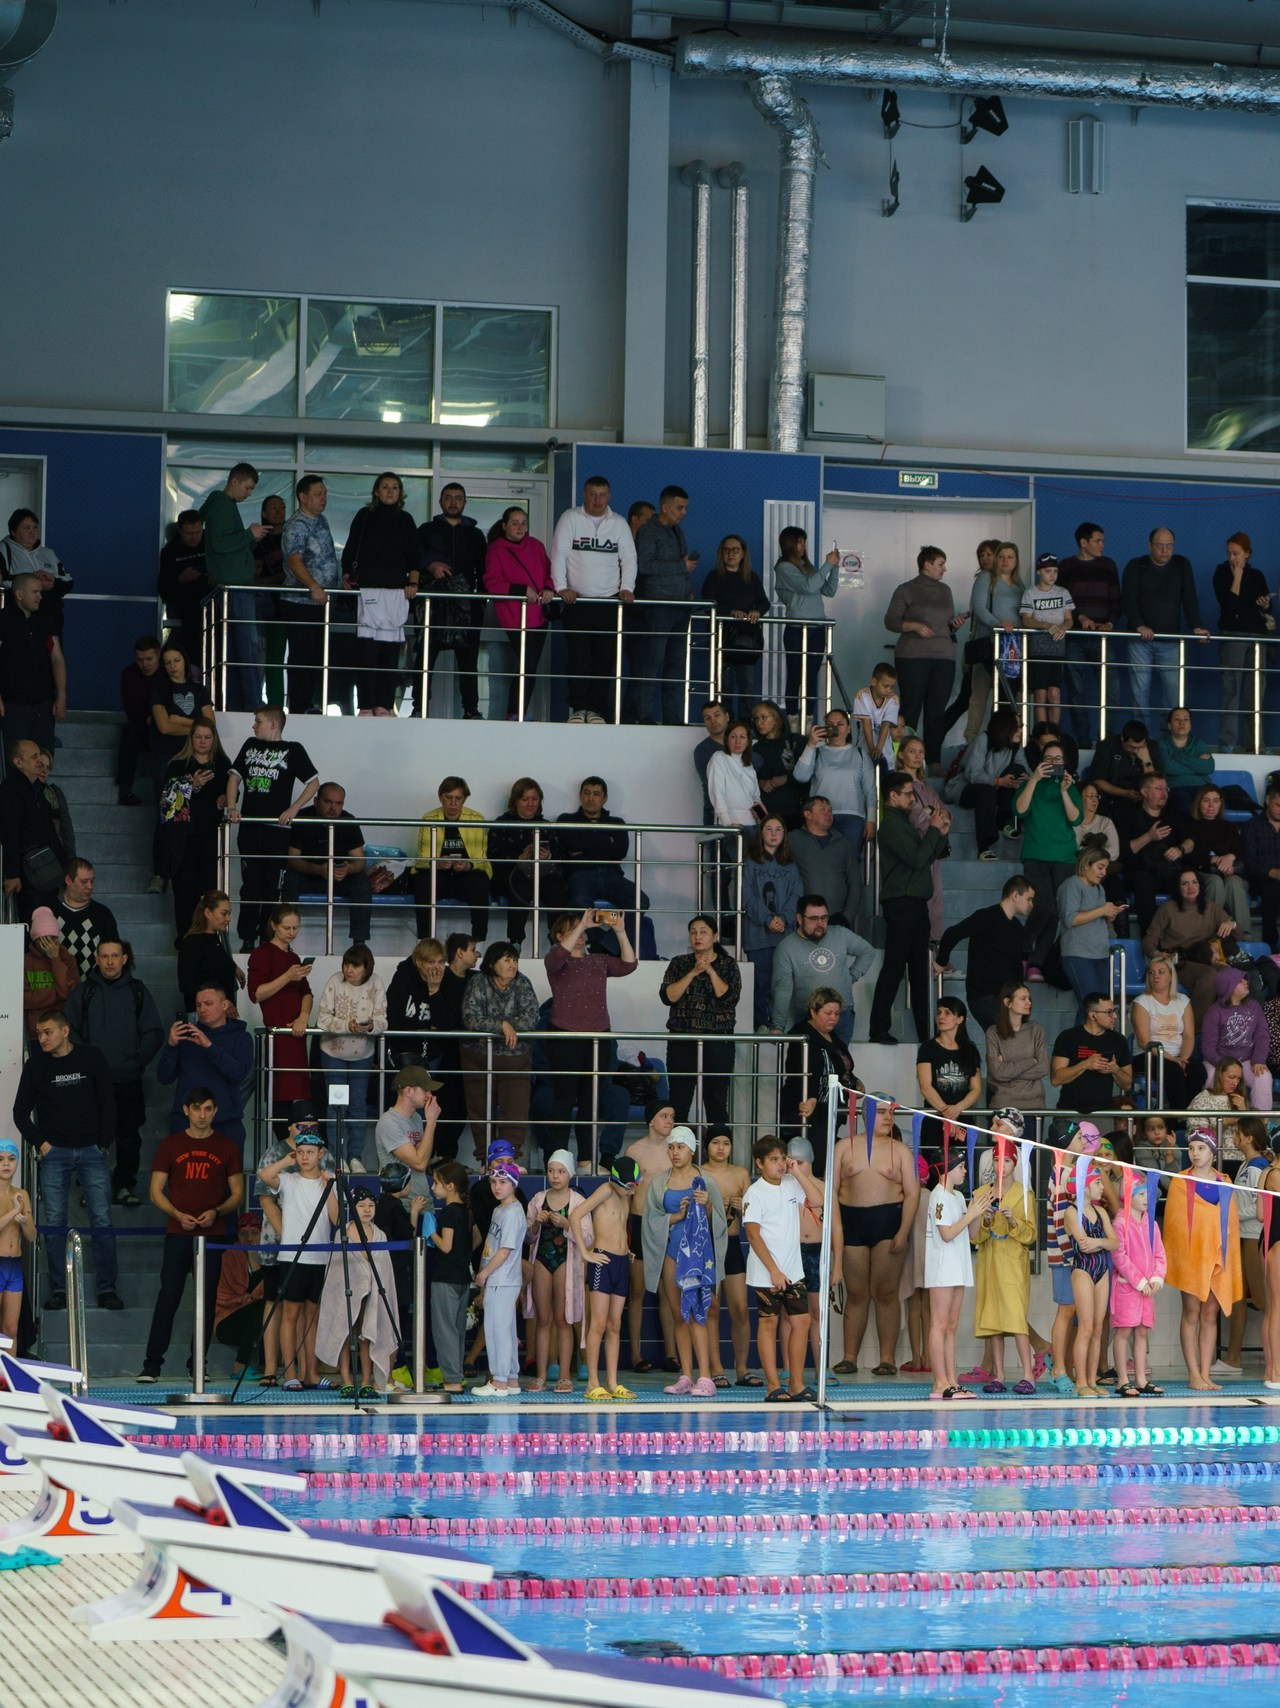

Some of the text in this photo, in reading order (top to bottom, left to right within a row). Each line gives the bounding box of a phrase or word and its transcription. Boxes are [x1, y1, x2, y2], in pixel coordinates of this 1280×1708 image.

[903, 475, 933, 485] ВЫХОД
[579, 537, 613, 550] FILA
[1036, 598, 1062, 610] #SKATE
[56, 1072, 81, 1082] BROKEN
[176, 1152, 189, 1163] NEW
[208, 1153, 221, 1165] CITY
[185, 1161, 210, 1179] NYC
